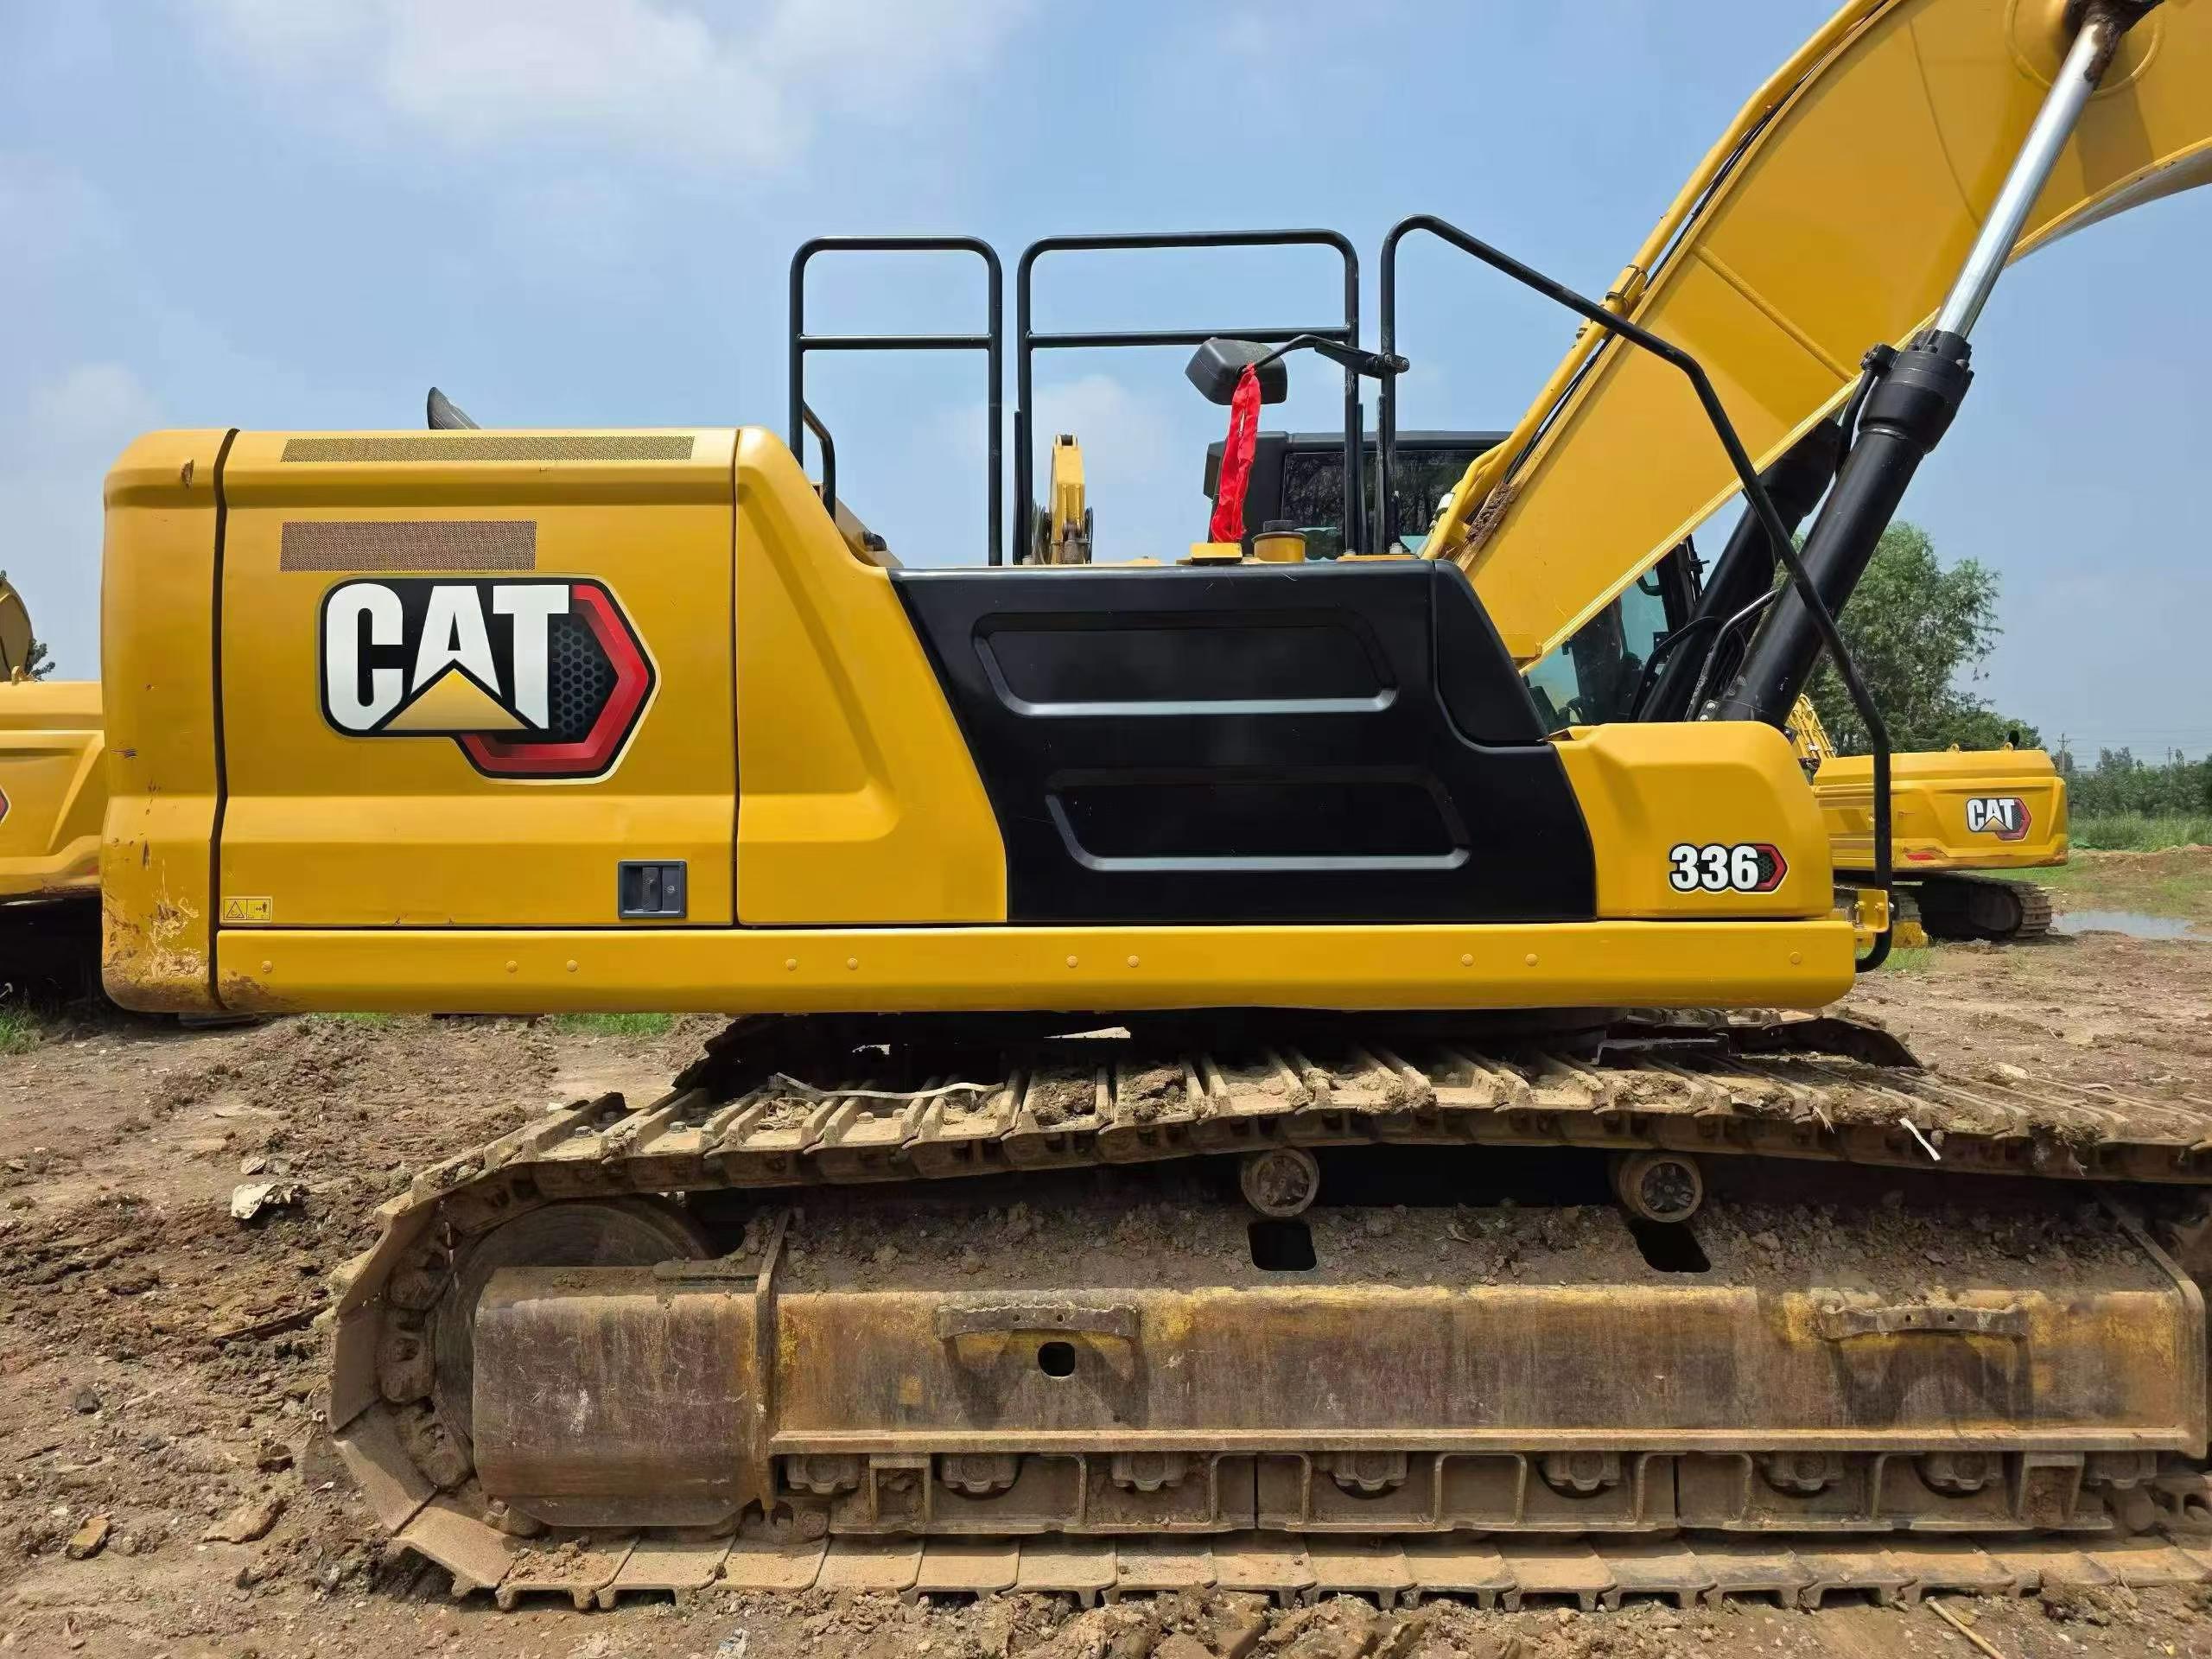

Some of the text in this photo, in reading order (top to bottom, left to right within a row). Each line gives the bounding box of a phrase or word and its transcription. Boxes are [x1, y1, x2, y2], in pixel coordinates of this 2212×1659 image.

[326, 582, 569, 731] CAT
[1967, 798, 2015, 832] CAT
[1670, 845, 1759, 890] 336
